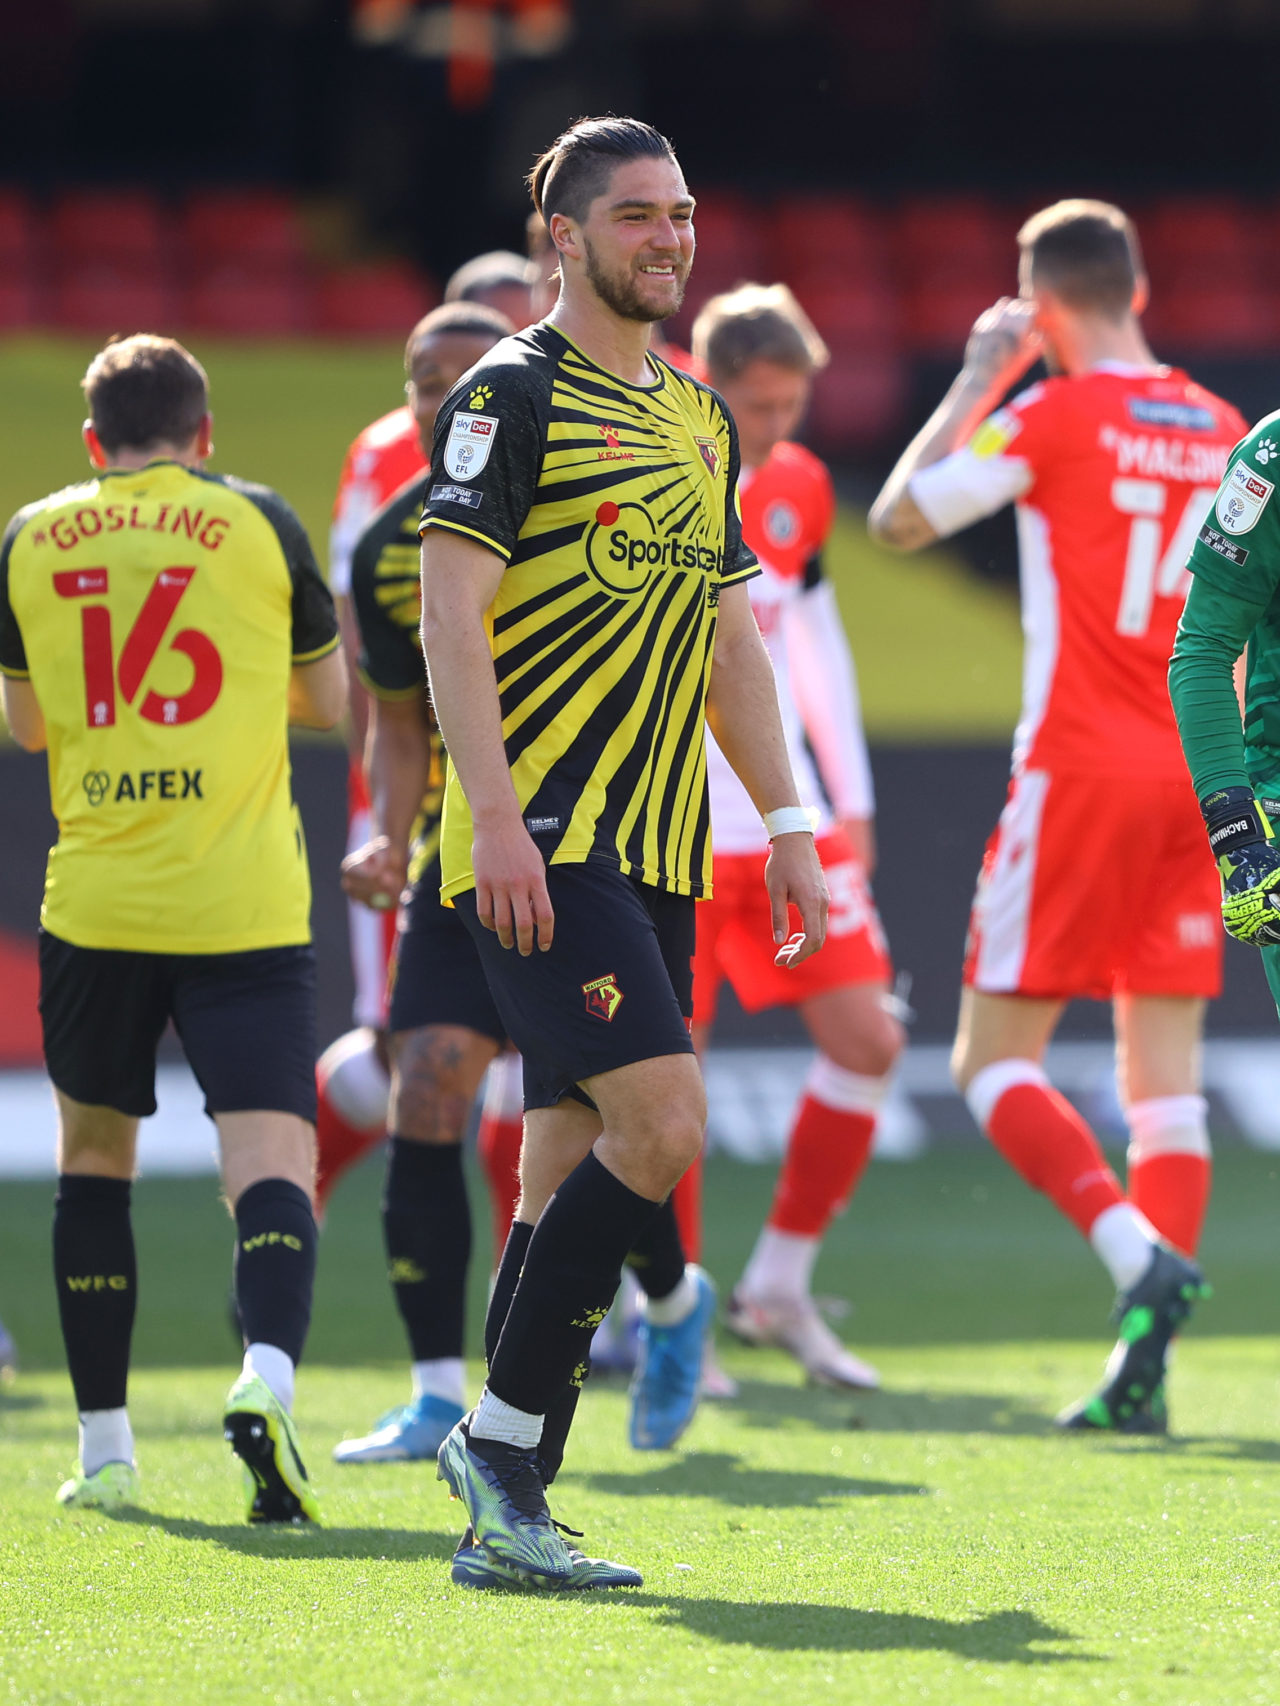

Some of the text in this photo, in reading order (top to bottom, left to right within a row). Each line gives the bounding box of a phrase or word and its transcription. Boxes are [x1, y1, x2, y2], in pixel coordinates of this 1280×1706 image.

[455, 418, 490, 433] sky bet
[453, 432, 489, 442] CHAMPIONSHIP
[598, 452, 636, 461] KELME
[455, 464, 469, 474] EFL
[1234, 469, 1265, 496] sky bet
[453, 486, 472, 498] TODAY
[1231, 481, 1261, 504] CHAMPIONSHIP
[459, 496, 472, 504] DAY
[50, 503, 231, 551] GOSLING
[1223, 514, 1236, 528] EFL
[1204, 535, 1238, 561] OR ANY DAY
[1208, 529, 1238, 553] NOT TODAY
[52, 565, 224, 729] 16
[114, 768, 203, 803] AFEX
[531, 817, 554, 825] KELME
[585, 977, 612, 991] WATFORD
[569, 1319, 602, 1328] KELM
